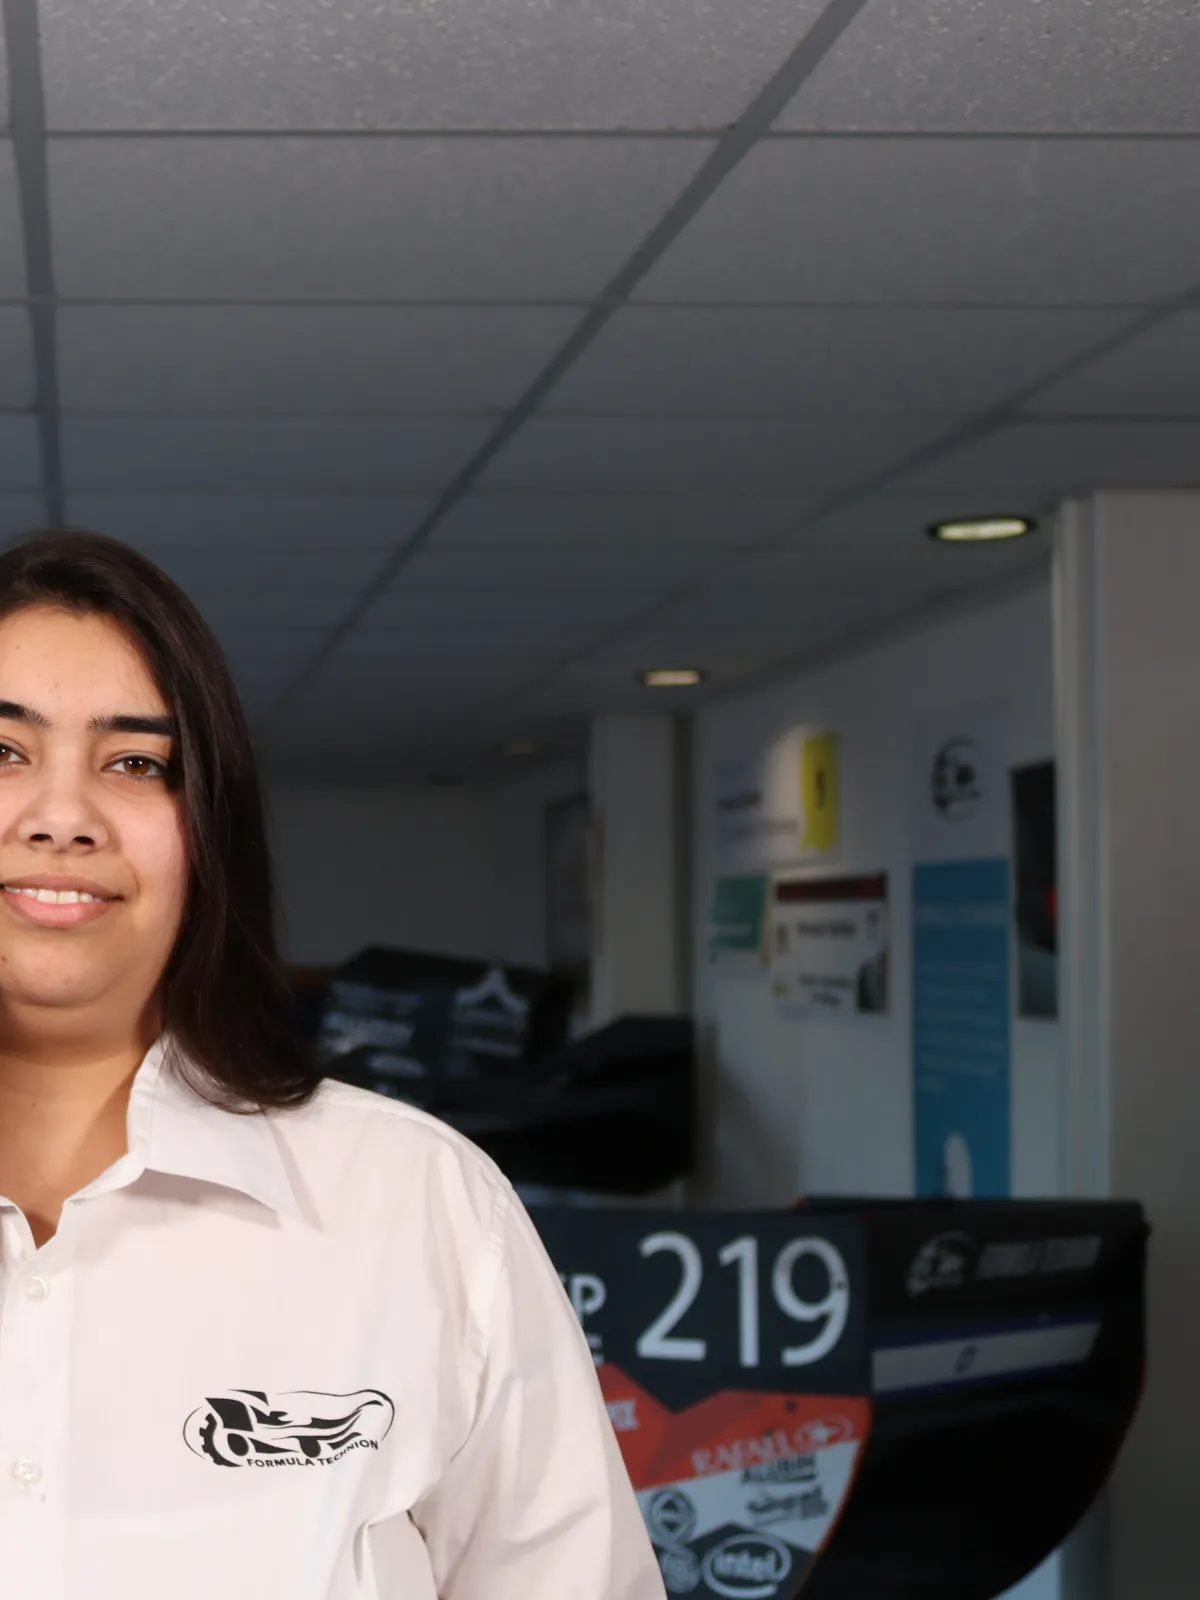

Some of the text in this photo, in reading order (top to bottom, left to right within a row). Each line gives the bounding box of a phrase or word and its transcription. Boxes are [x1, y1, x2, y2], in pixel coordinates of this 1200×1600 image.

[637, 1231, 849, 1367] 219
[247, 1439, 379, 1468] FORMULA TECHNION
[714, 1549, 776, 1581] intel
